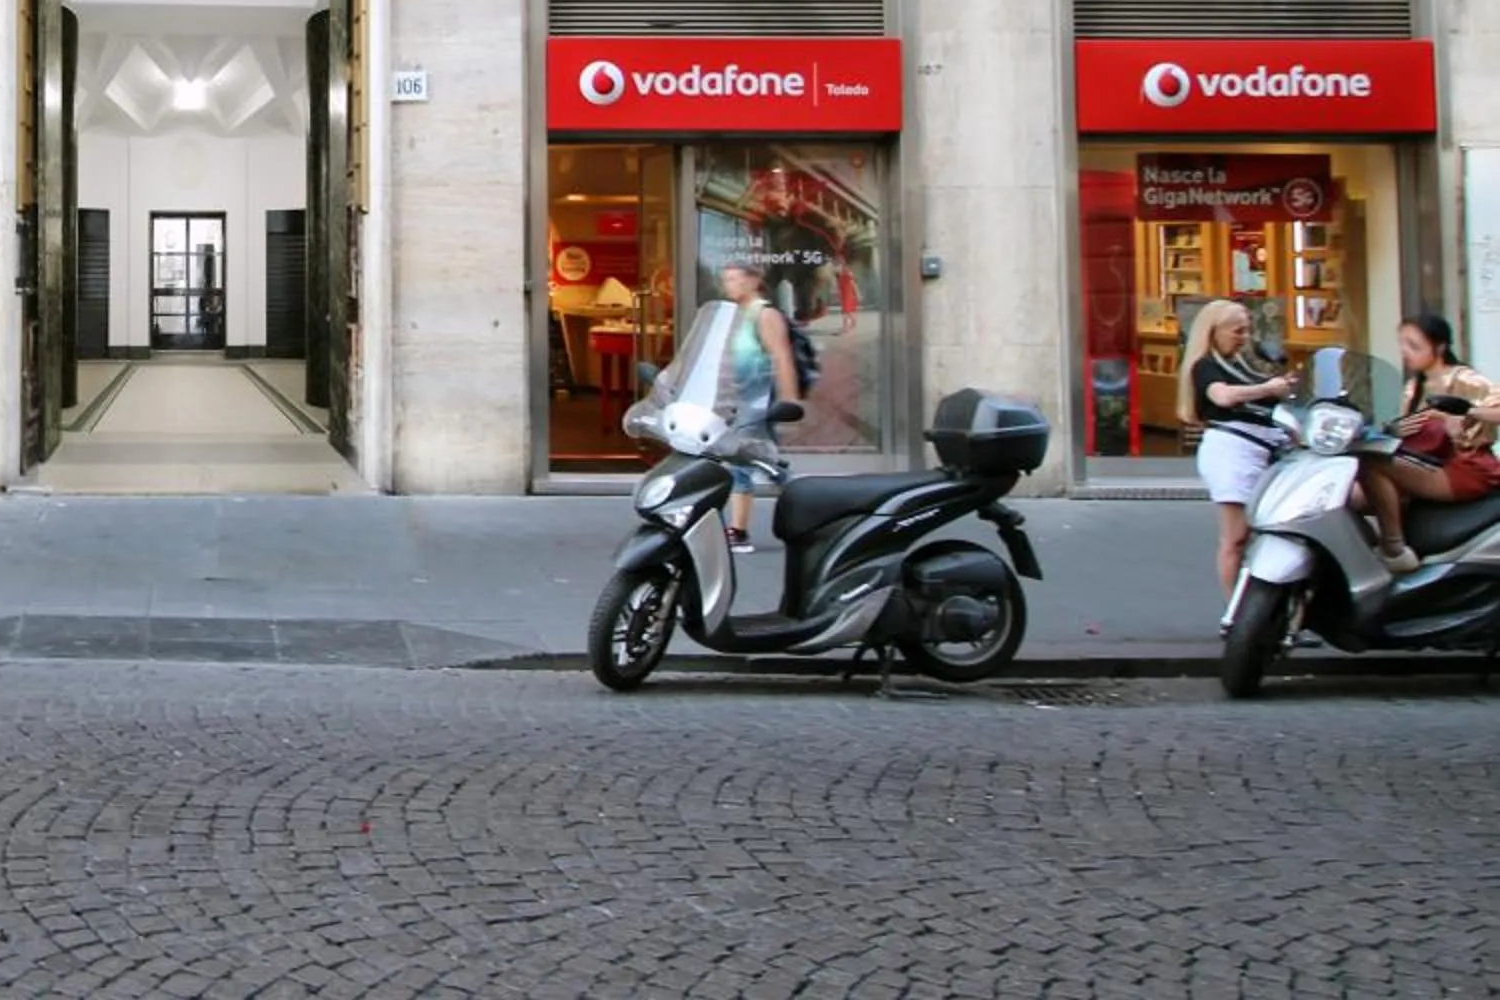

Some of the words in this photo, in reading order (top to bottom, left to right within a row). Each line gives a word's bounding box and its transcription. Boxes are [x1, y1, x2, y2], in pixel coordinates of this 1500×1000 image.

[397, 78, 423, 94] 106
[632, 64, 804, 96] vodafone
[825, 83, 869, 96] Toledo
[1198, 65, 1371, 97] vodafone
[1143, 165, 1204, 184] Nasce
[1208, 167, 1227, 184] la
